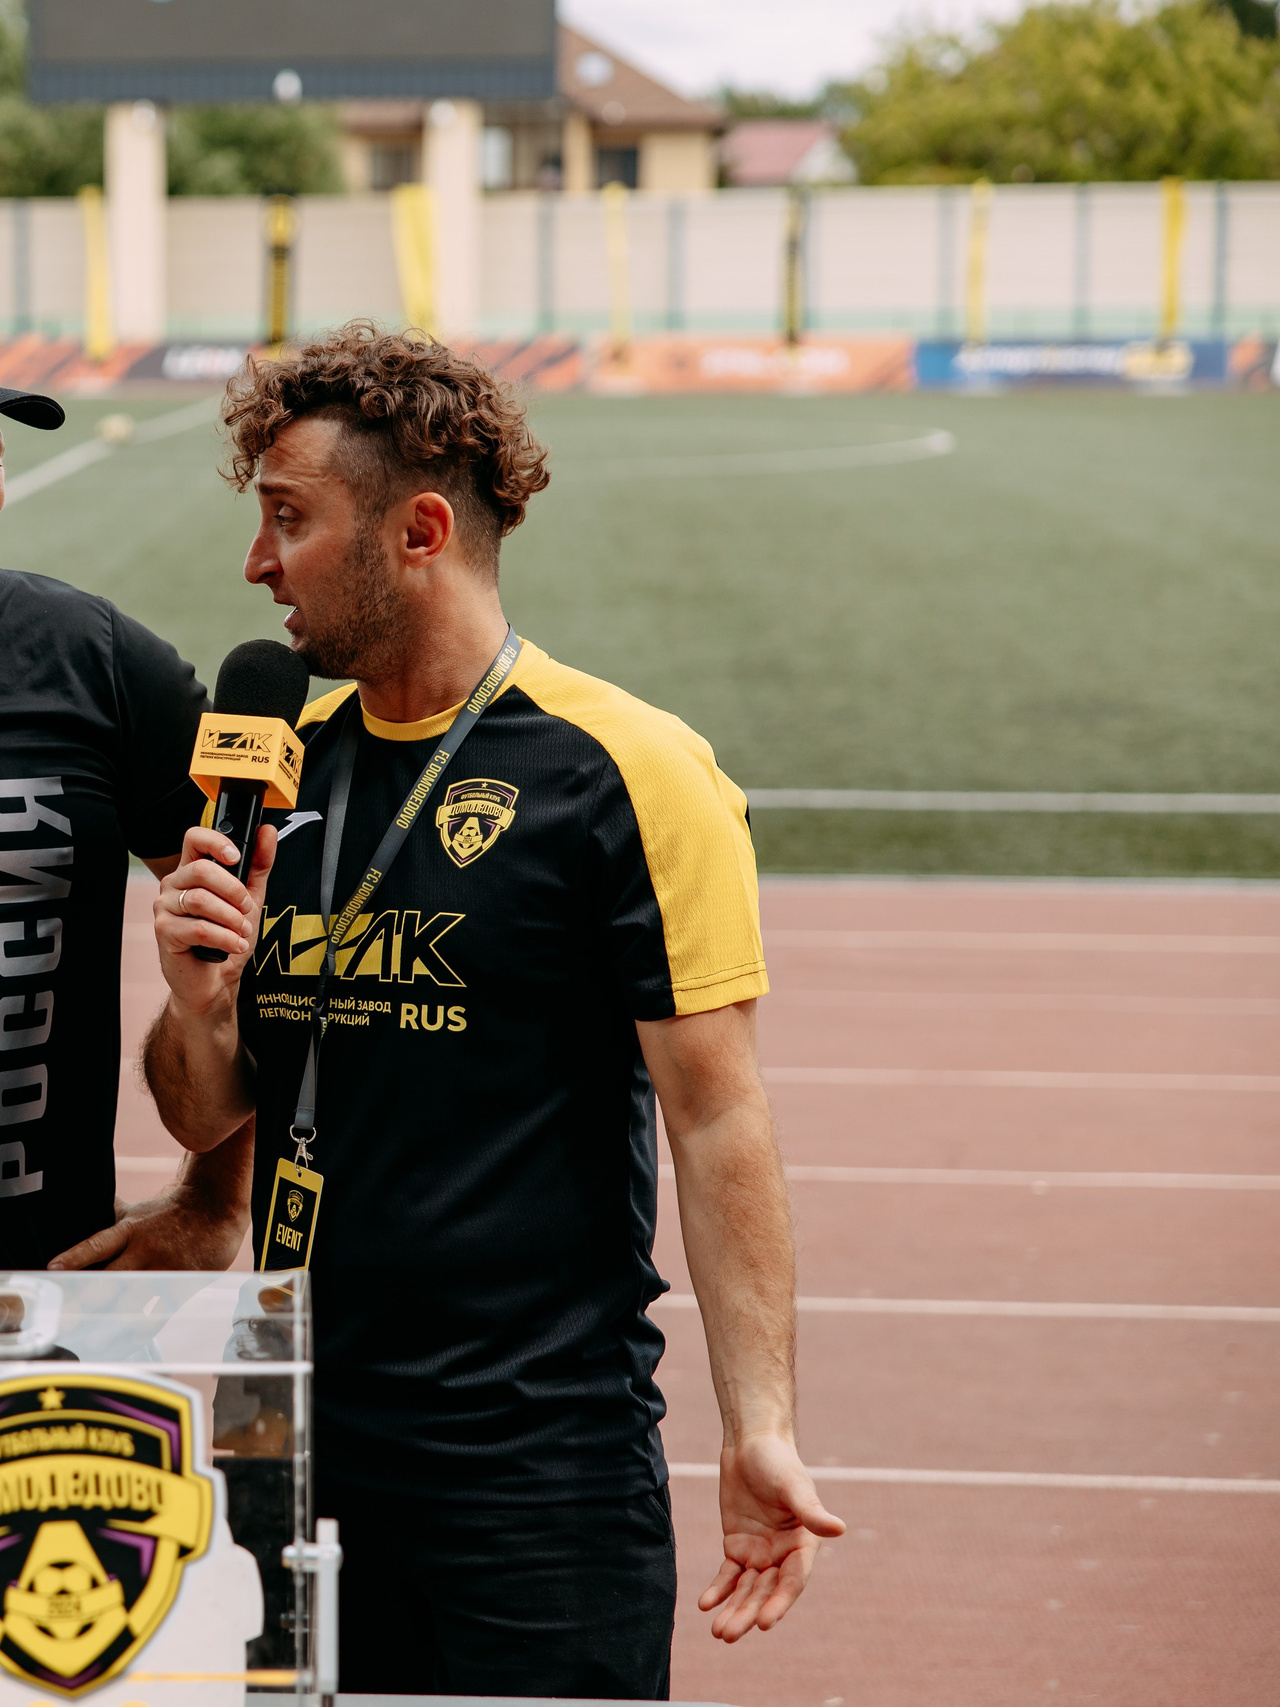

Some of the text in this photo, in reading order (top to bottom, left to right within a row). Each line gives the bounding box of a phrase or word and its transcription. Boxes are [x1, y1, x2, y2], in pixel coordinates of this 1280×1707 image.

[467, 644, 517, 714] FC DOMODEDOVO
[251, 755, 269, 764] RUS
[396, 749, 450, 829] FC DOMODEDOVO
[331, 868, 382, 944] FC DOMODEDOVO
[357, 999, 392, 1013] ЗАВОД
[399, 1003, 468, 1032] RUS
[275, 1222, 303, 1251] EVENT
